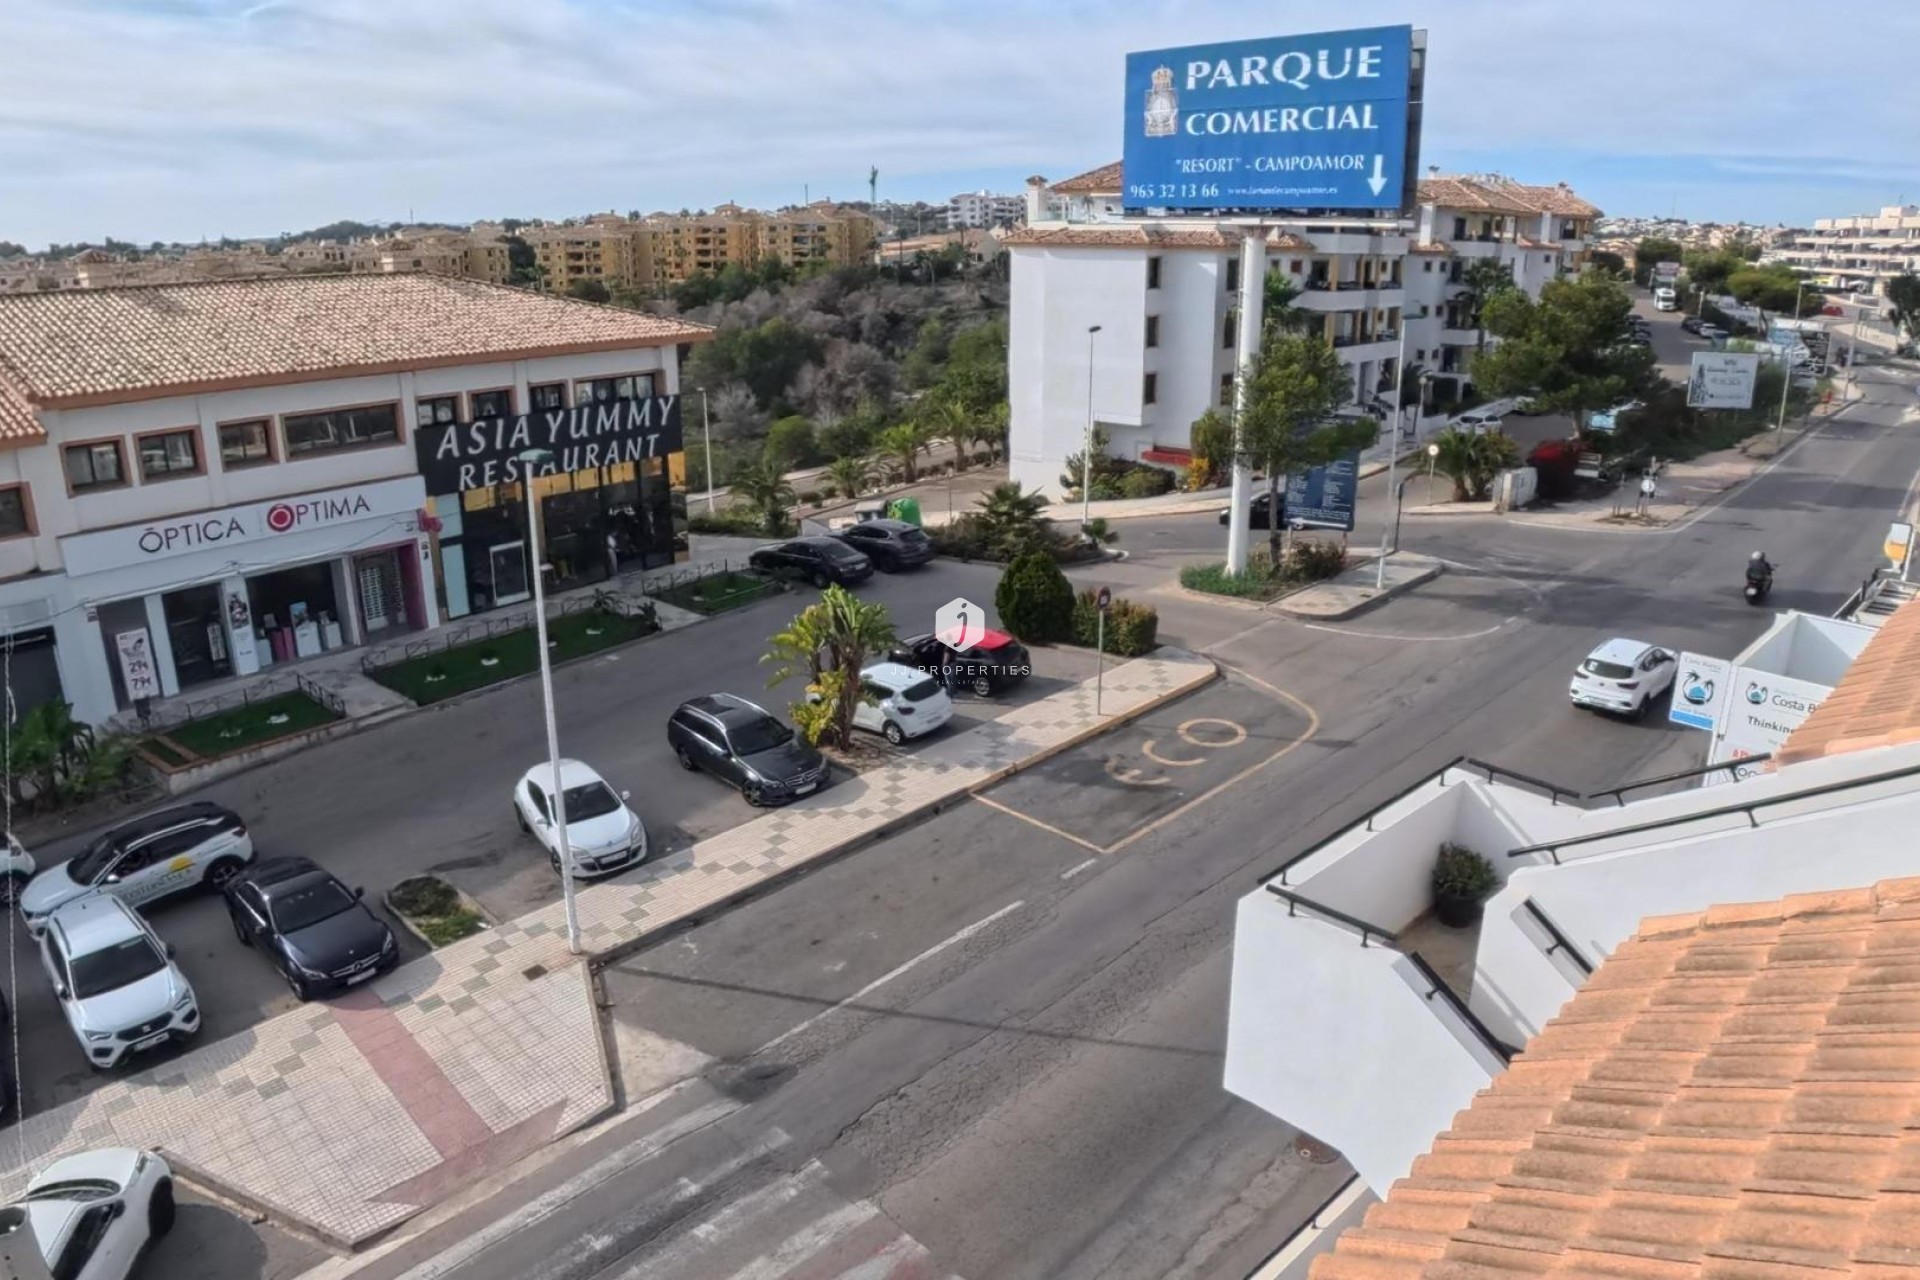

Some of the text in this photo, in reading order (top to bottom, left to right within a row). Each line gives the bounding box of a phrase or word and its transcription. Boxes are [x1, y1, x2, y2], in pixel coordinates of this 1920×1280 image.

[1186, 46, 1382, 90] PARQUE
[1186, 104, 1379, 136] COMERCIAL
[1175, 157, 1243, 173] "RESORT"
[1255, 154, 1365, 172] CAMPOAMOR
[1130, 184, 1155, 199] 965
[1159, 183, 1176, 198] 32
[1181, 183, 1197, 198] 13
[1201, 183, 1219, 198] 66
[436, 415, 531, 459] ASIA
[546, 395, 674, 443] YUMMY
[459, 433, 660, 491] RESAURANT
[1772, 694, 1805, 712] Costa
